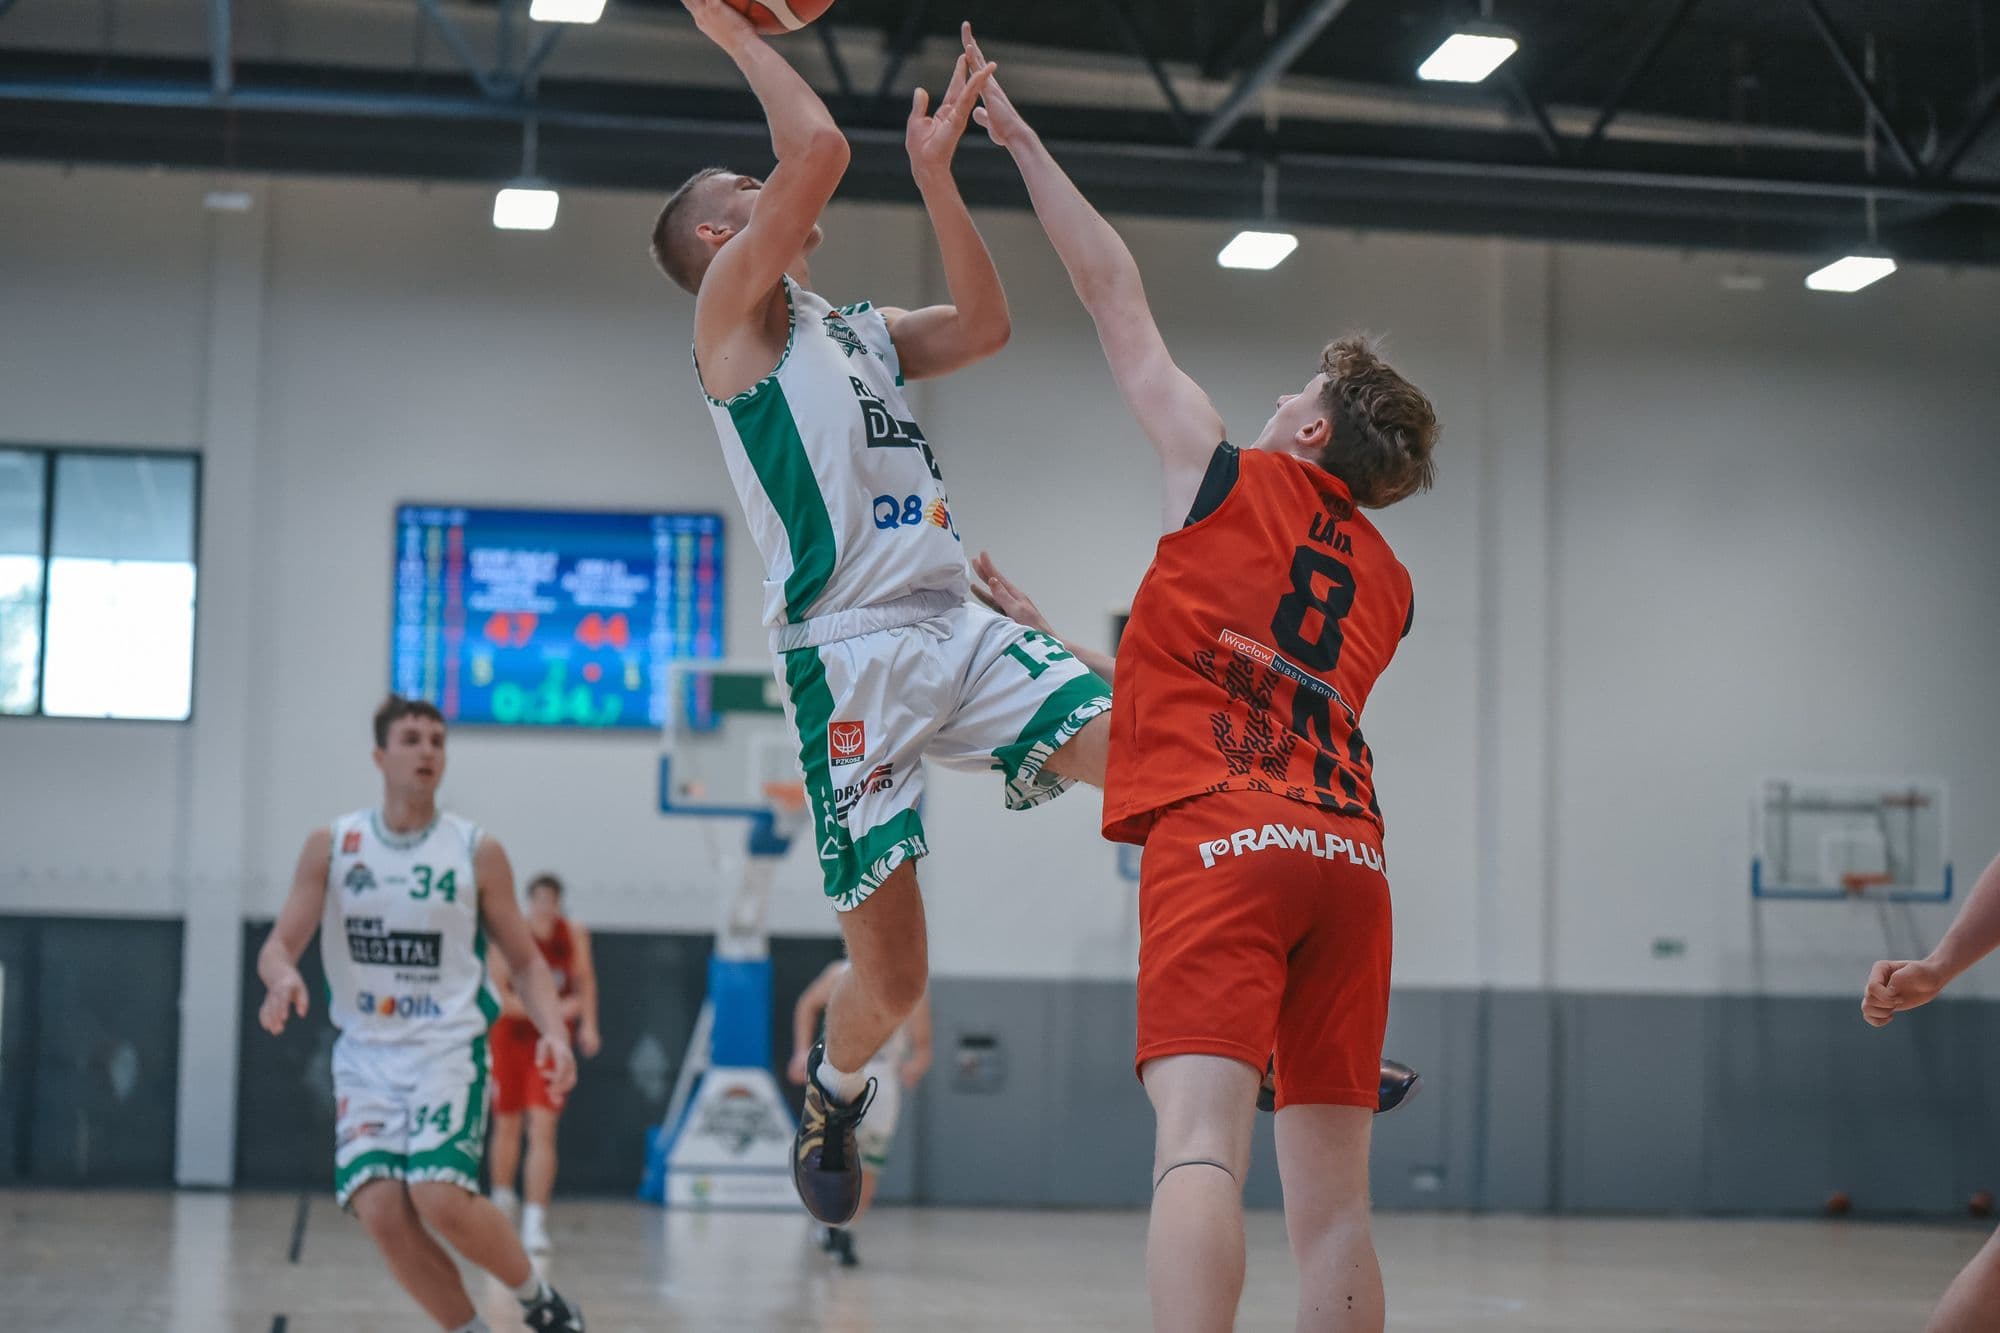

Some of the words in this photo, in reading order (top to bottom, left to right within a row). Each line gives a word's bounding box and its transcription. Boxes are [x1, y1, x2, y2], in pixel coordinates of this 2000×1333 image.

[873, 494, 922, 529] Q8
[1271, 545, 1356, 672] 8
[484, 610, 539, 646] 47
[575, 613, 630, 650] 44
[1002, 630, 1074, 680] 13
[1274, 659, 1307, 686] miasto
[409, 864, 456, 902] 34
